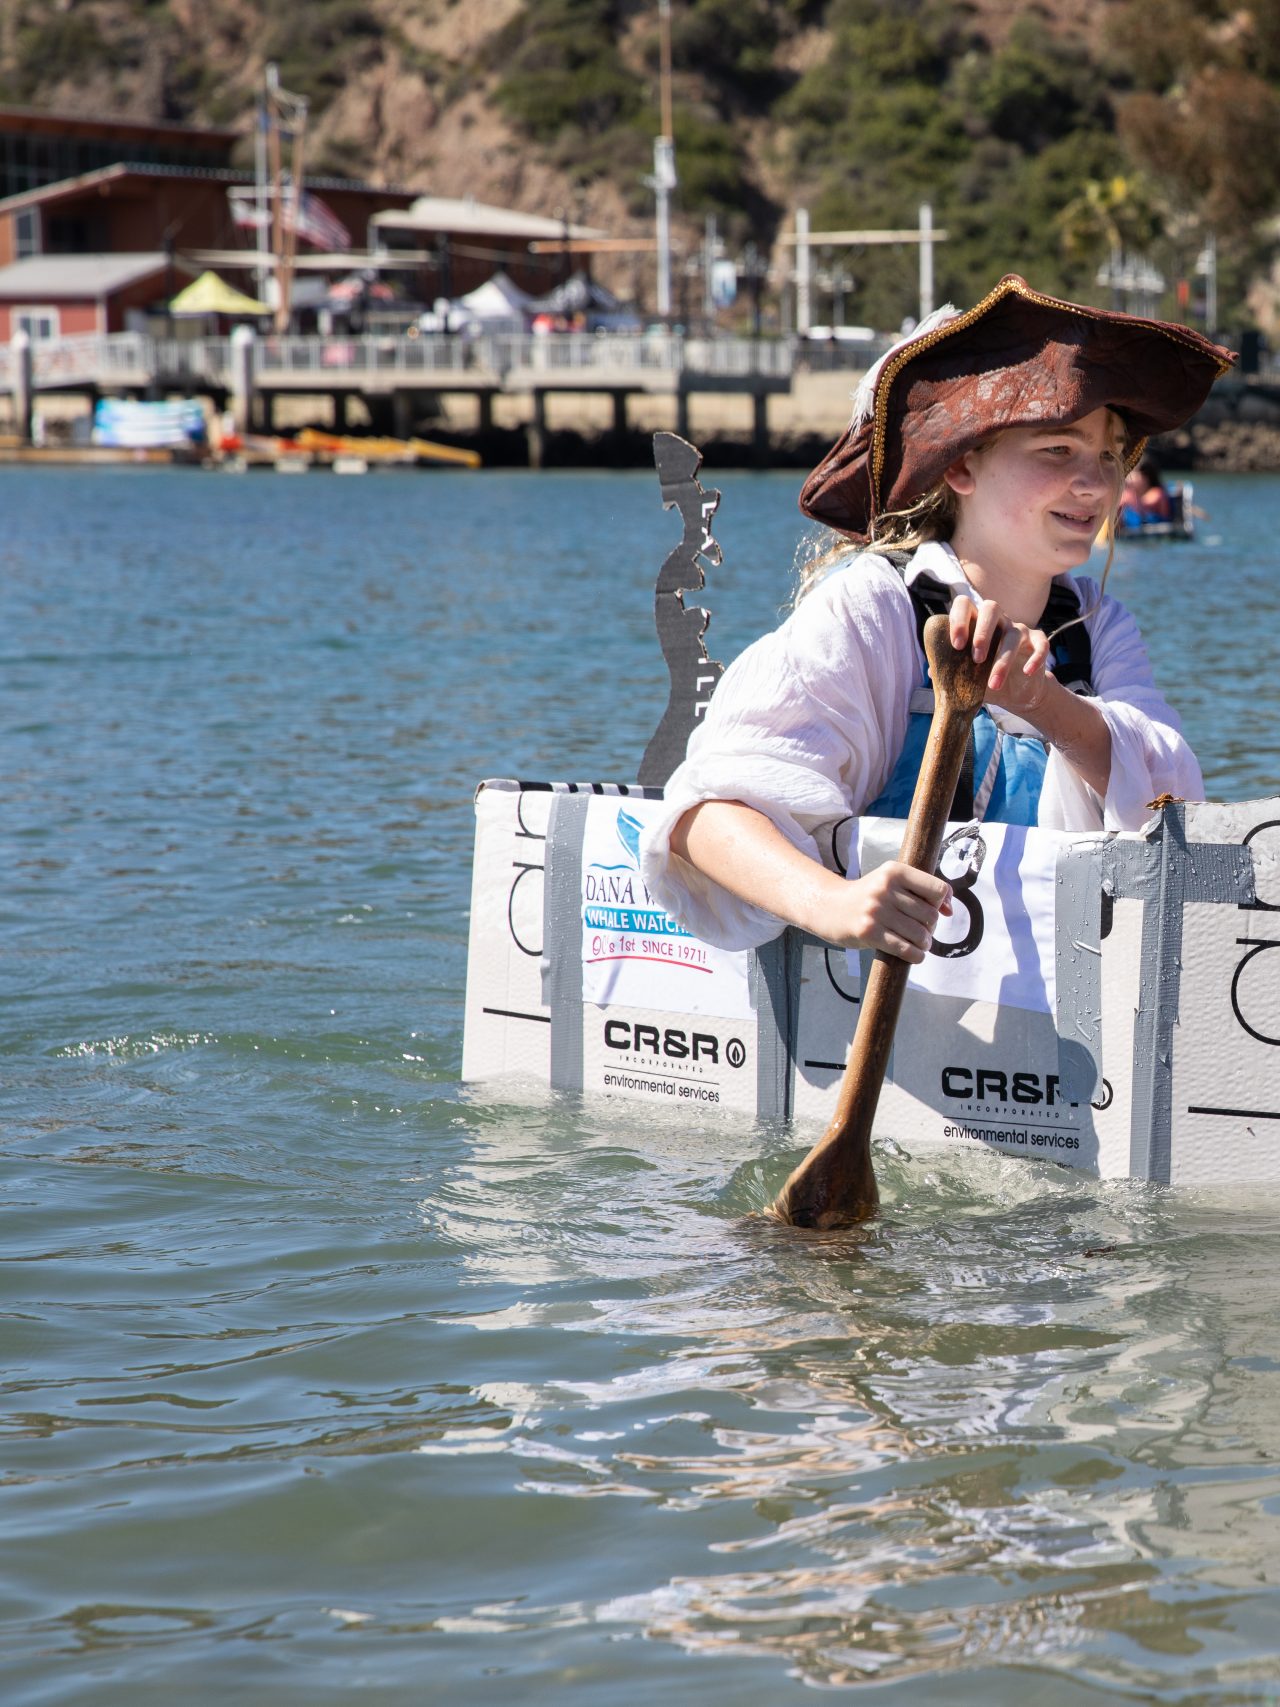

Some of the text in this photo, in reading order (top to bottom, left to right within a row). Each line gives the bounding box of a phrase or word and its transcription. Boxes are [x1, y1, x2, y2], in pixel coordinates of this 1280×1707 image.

[585, 874, 636, 905] DANA
[586, 909, 630, 929] WHALE
[619, 935, 636, 952] 1st
[642, 940, 673, 956] SINCE
[678, 945, 707, 964] 1971!
[604, 1019, 719, 1065] CR&R
[619, 1054, 704, 1074] INCORPORATED
[604, 1073, 720, 1103] environmental services
[960, 1103, 1060, 1119] INCORPORATED
[943, 1125, 1080, 1150] environmental services
